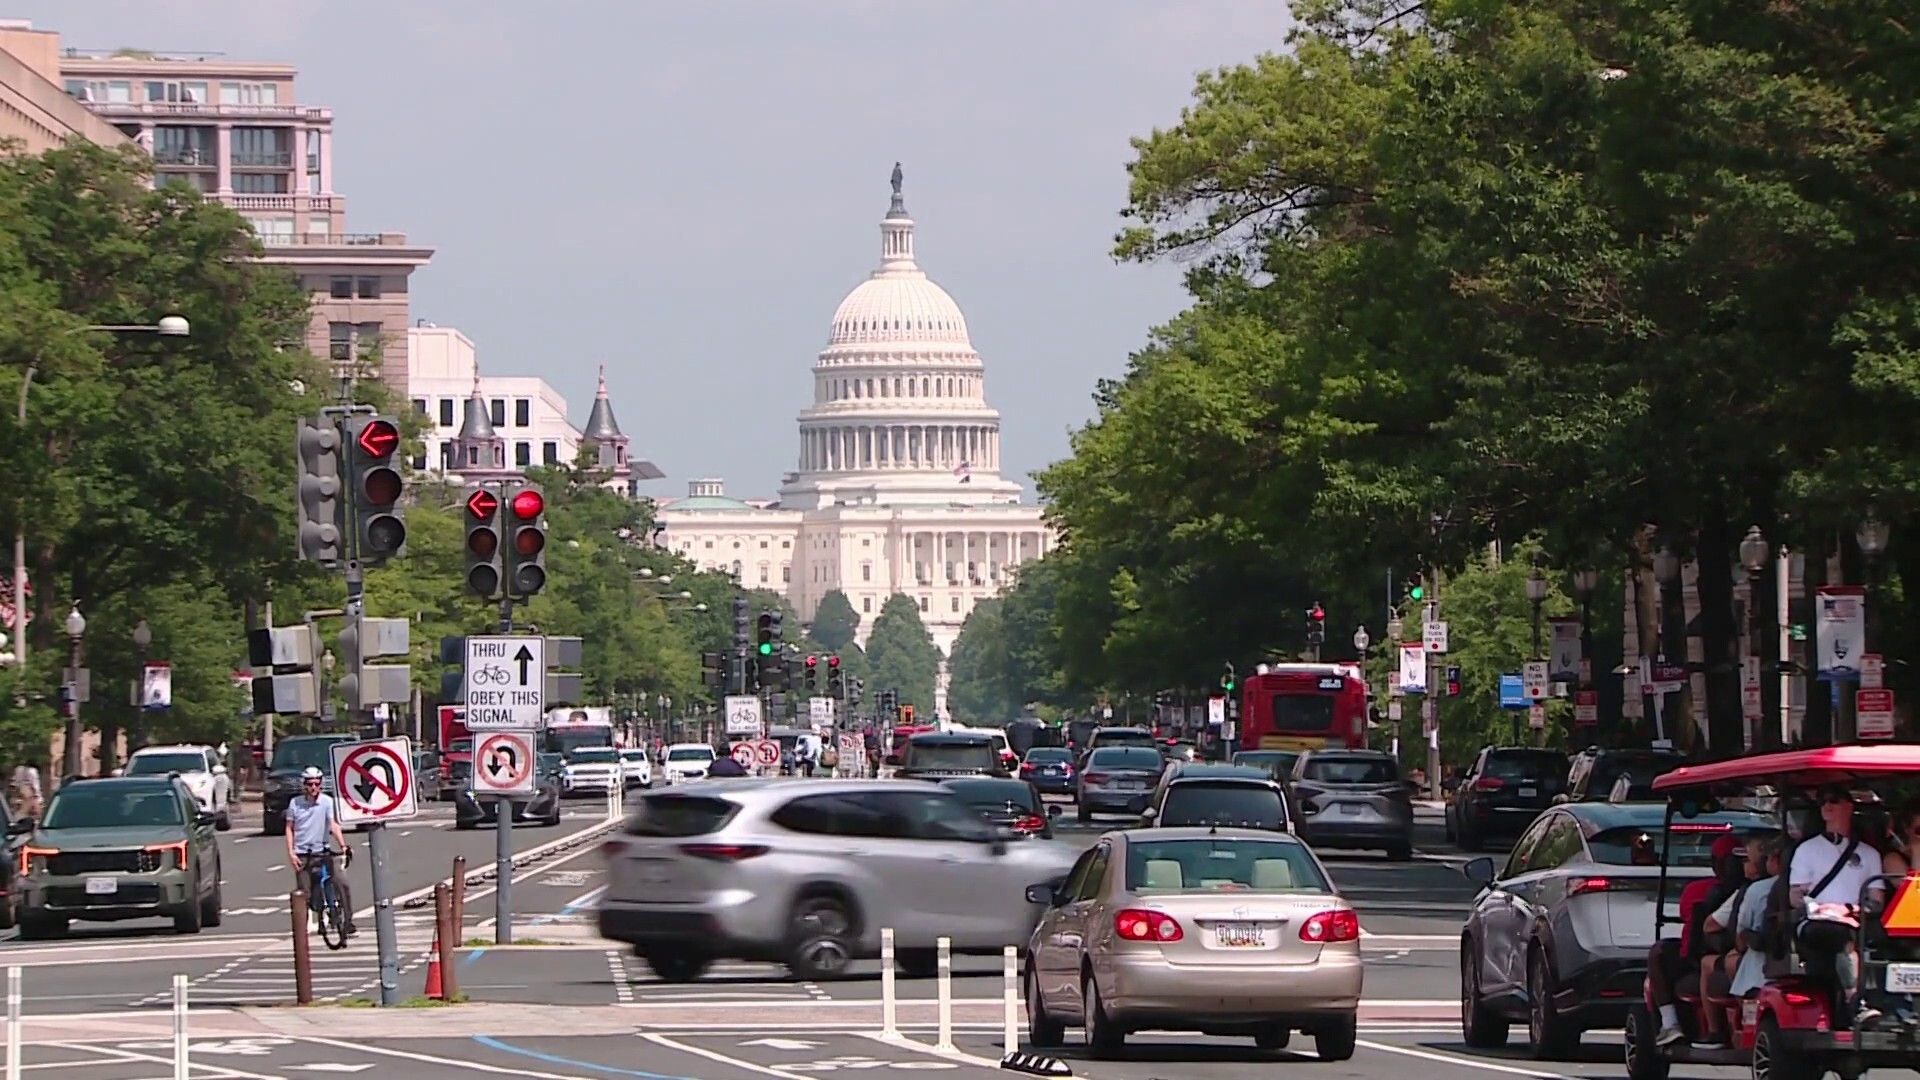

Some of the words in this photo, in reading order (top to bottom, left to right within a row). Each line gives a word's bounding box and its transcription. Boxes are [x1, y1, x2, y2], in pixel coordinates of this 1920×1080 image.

[472, 643, 506, 658] THRU
[470, 691, 505, 706] OBEY
[511, 691, 539, 706] THIS
[470, 709, 516, 723] SIGNAL
